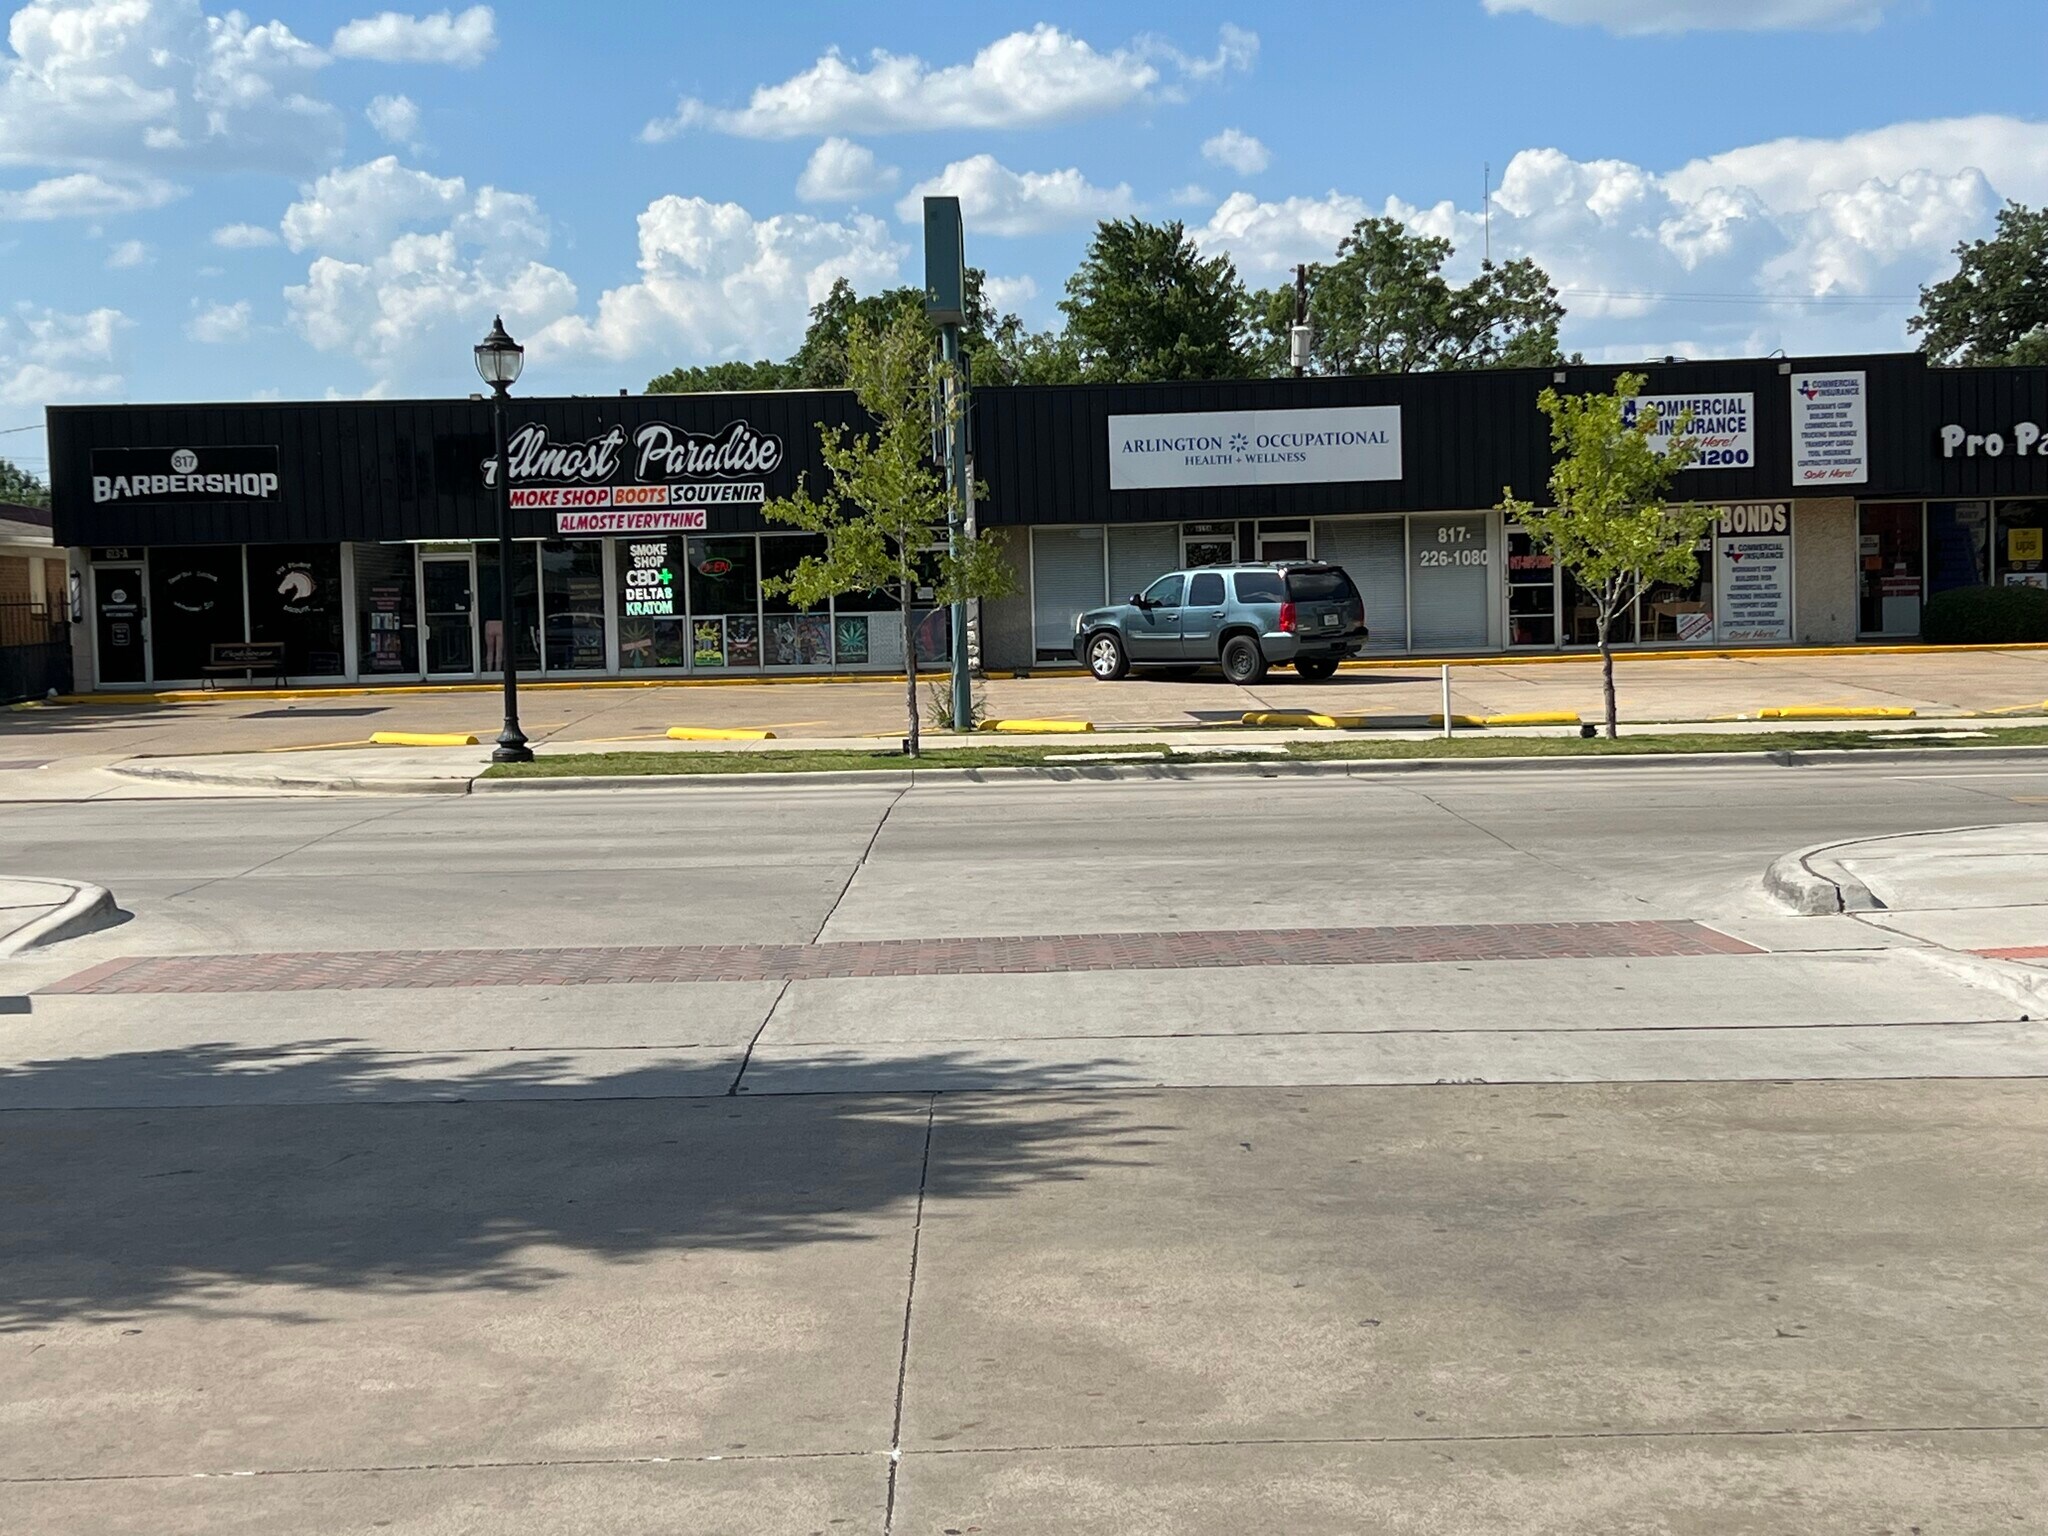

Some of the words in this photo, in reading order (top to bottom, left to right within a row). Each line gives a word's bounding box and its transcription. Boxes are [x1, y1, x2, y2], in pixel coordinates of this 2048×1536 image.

[1659, 417, 1747, 435] INURANCE
[1122, 436, 1222, 454] ARLINGTON
[1256, 431, 1389, 448] OCCUPATIONAL
[1940, 424, 2004, 457] Pro
[636, 424, 777, 477] Paradise
[1184, 454, 1233, 466] HEALTH
[1245, 452, 1307, 464] WELLNESS
[173, 455, 195, 468] 817
[92, 472, 278, 503] BARBERSHOP
[614, 488, 667, 504] BOOTS
[672, 484, 763, 502] SOUVENIR
[510, 489, 558, 506] MOKE
[562, 488, 609, 505] SHOP
[1719, 504, 1787, 533] BONDS
[629, 543, 668, 557] SMOKE
[633, 556, 664, 568] SHOP
[626, 600, 673, 616] KRATOM
